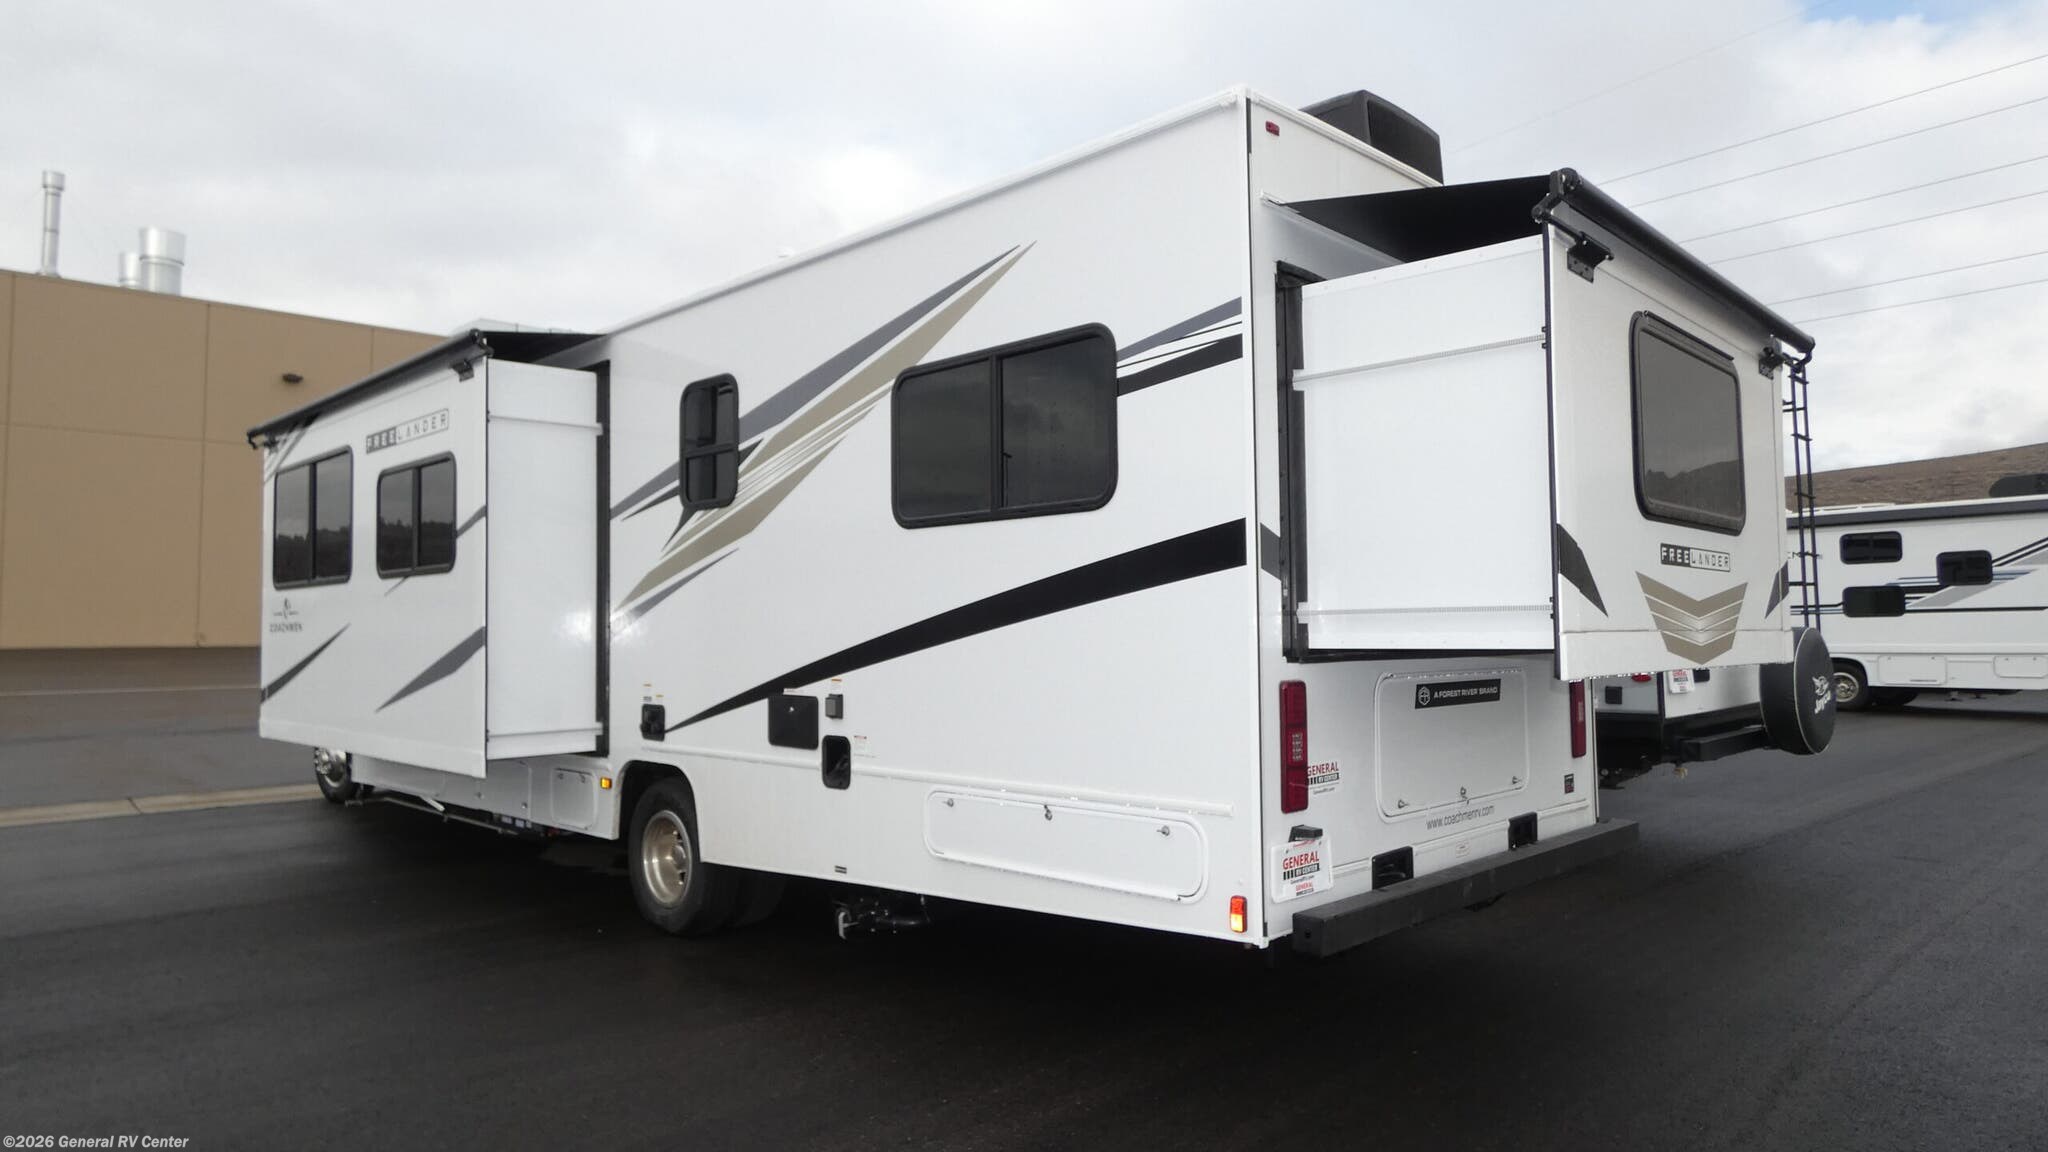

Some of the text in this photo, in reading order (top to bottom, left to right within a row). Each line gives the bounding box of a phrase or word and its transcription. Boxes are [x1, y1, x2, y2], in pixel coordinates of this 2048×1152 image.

[367, 411, 447, 453] FREELANDER
[1661, 546, 1729, 570] FREELANDER
[1440, 689, 1460, 698] FOREST
[1461, 688, 1478, 696] RIVER
[1479, 686, 1498, 695] BRAND
[1308, 762, 1339, 776] GENERAL
[1283, 851, 1320, 870] GENERAL
